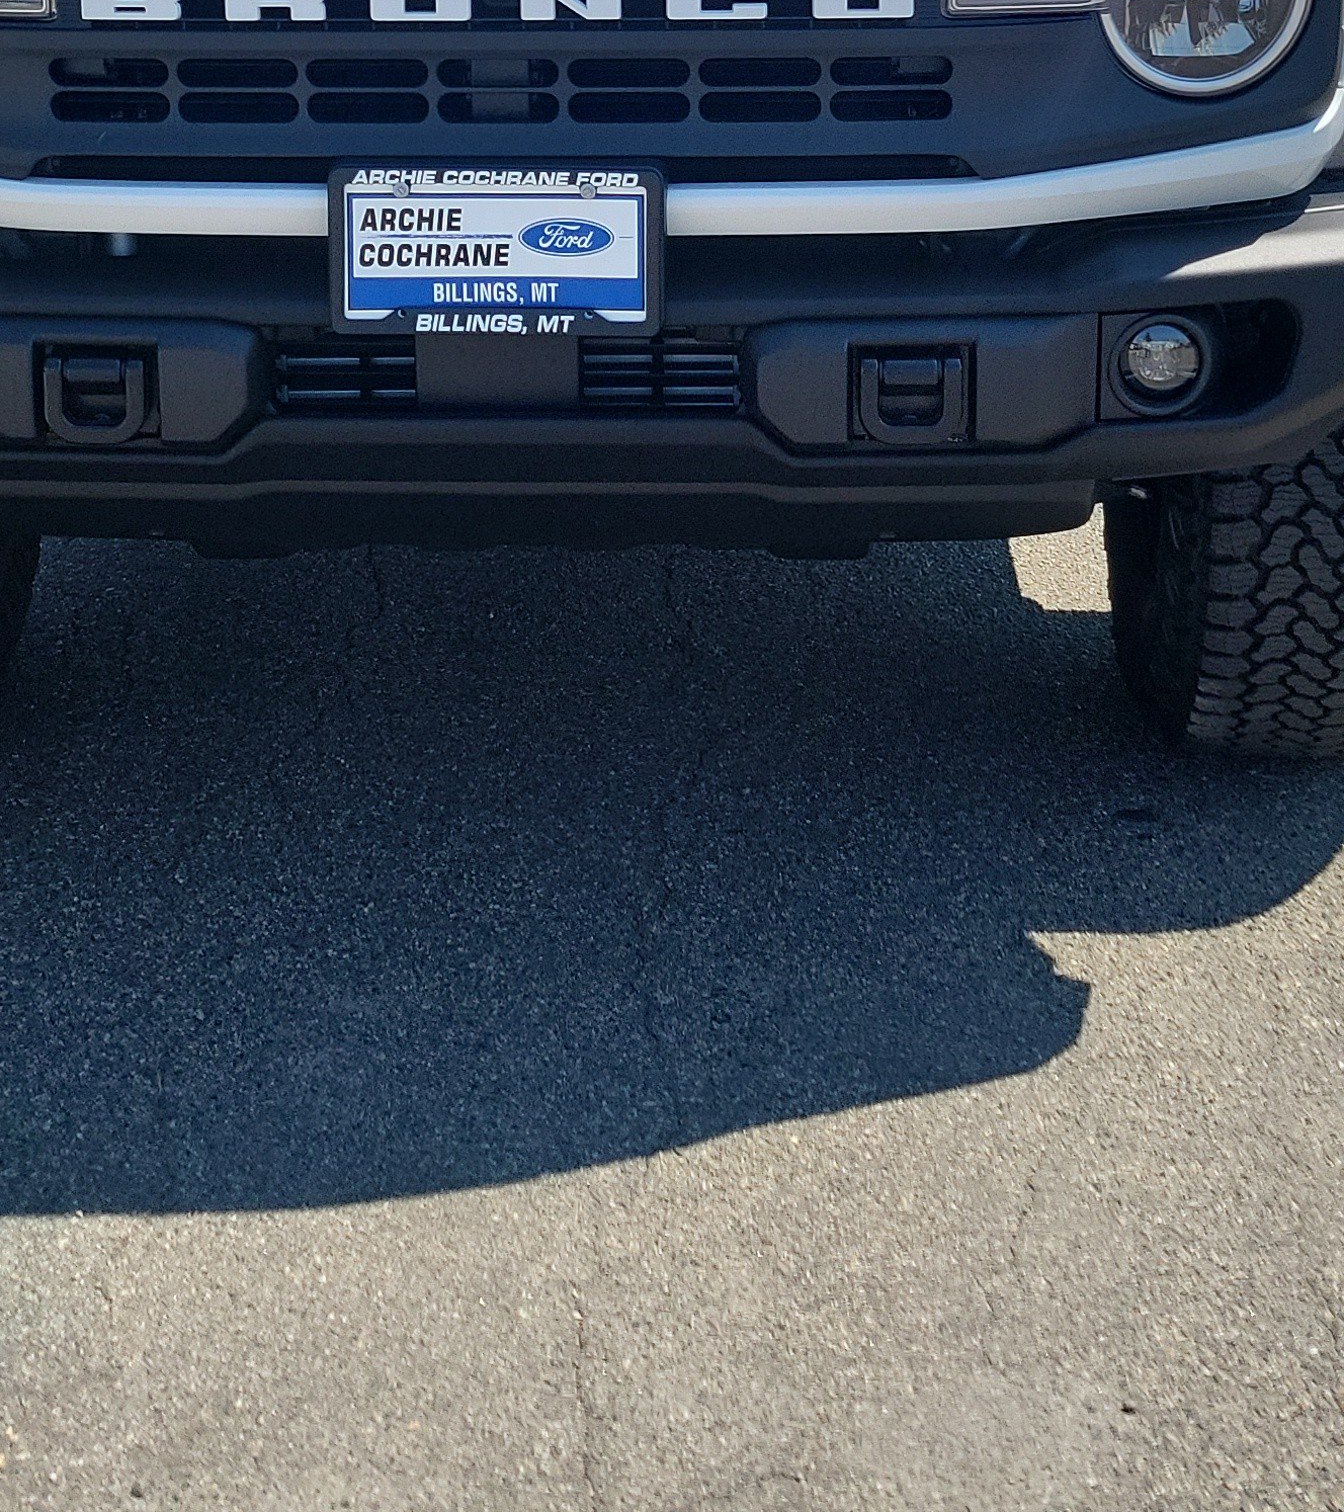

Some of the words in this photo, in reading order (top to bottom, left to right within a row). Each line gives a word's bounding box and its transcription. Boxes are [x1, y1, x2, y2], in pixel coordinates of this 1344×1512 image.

[351, 169, 436, 185] ARCHIE
[442, 170, 572, 187] COCHRANE
[575, 172, 639, 188] FORD
[359, 207, 463, 232] ARCHIE
[538, 224, 595, 250] Ford
[358, 243, 511, 268] COCHRANE
[432, 282, 525, 305] BILLINGS,
[531, 282, 559, 303] MT
[415, 313, 529, 336] BILLINGS,
[536, 315, 575, 334] MT
